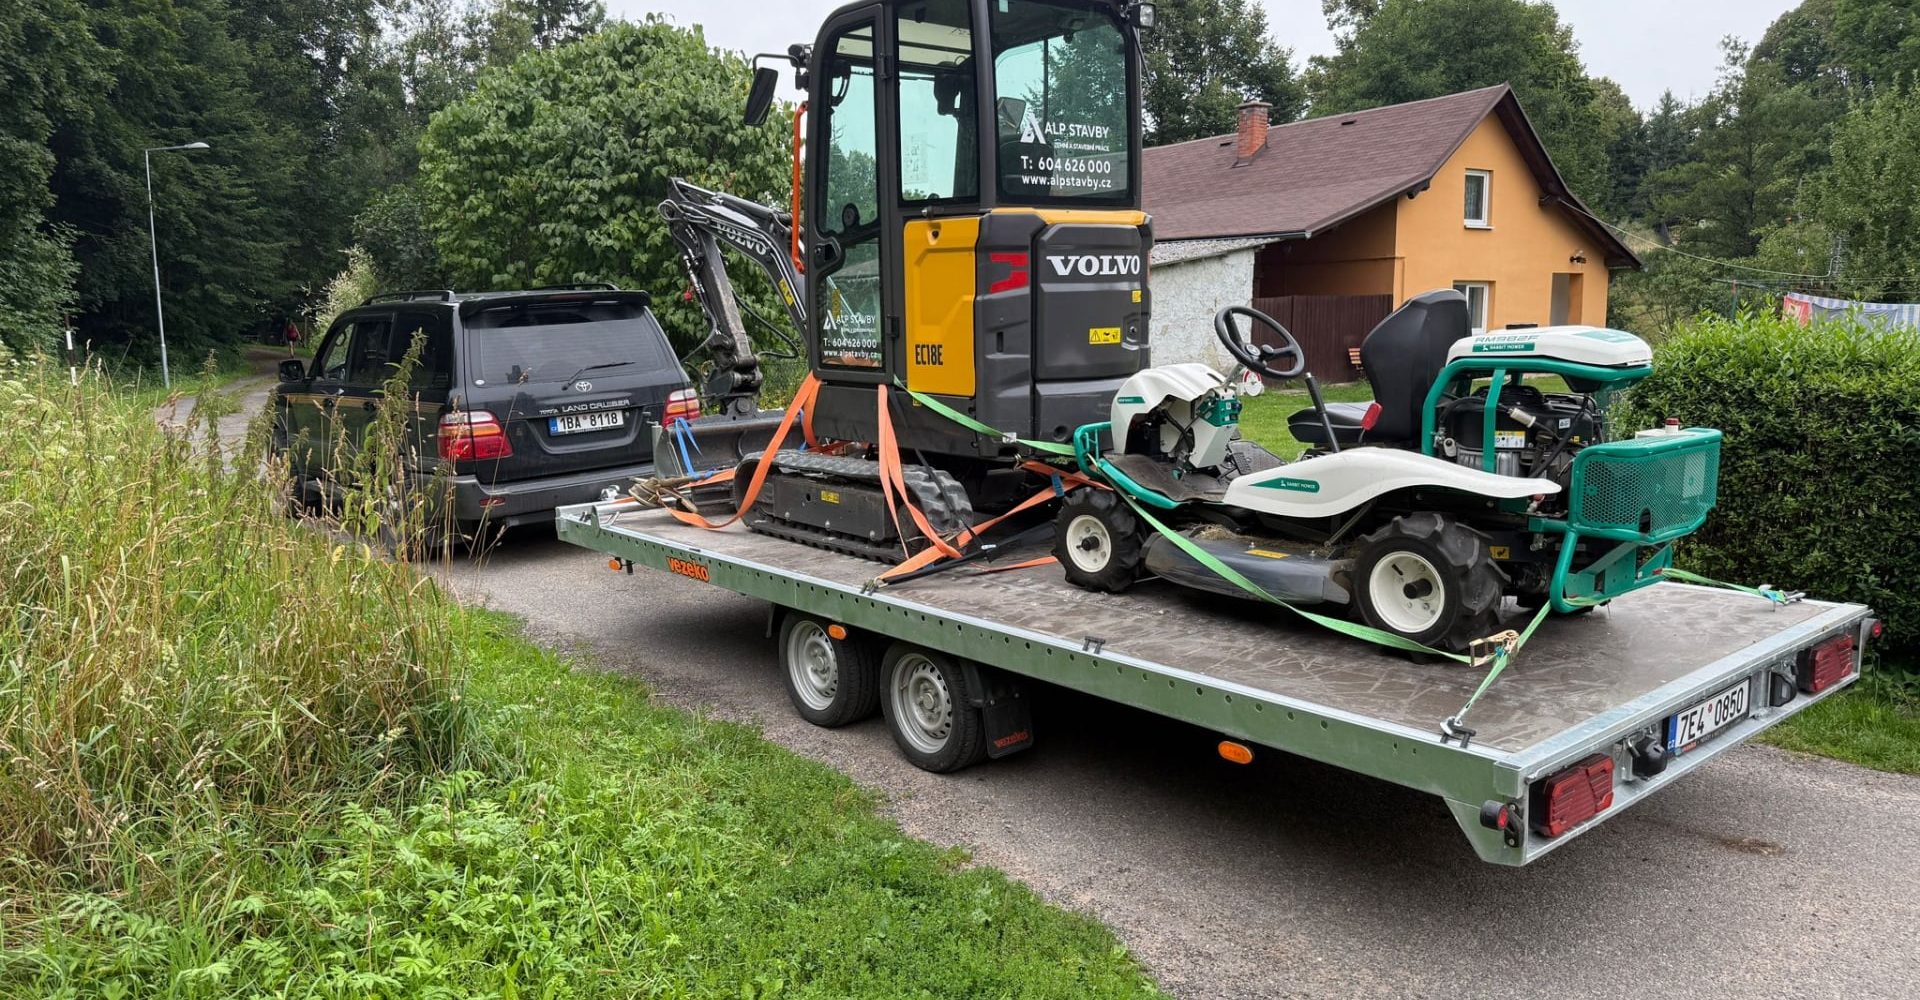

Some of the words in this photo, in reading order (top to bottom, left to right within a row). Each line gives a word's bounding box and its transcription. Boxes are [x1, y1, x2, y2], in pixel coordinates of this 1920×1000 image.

[1044, 121, 1066, 135] ALP
[1069, 124, 1109, 138] STAVBY
[1021, 155, 1033, 170] T:
[1038, 157, 1062, 171] 604
[1064, 158, 1086, 172] 626
[1087, 160, 1111, 174] 000
[1021, 174, 1112, 191] www.alpstavby.cz
[716, 221, 768, 255] VOLVO
[1046, 254, 1140, 276] VOLVO
[823, 337, 831, 347] T:
[861, 339, 878, 348] 000
[823, 349, 878, 360] www.alpstavby.cz
[915, 344, 943, 366] EC18E
[561, 403, 588, 413] LAND
[589, 399, 630, 410] CRUISER
[560, 415, 582, 430] 1BA
[589, 412, 618, 427] 8118
[666, 556, 709, 583] vezeko
[1680, 707, 1705, 744] 7E4
[1714, 687, 1744, 726] 0850
[1667, 739, 1675, 749] CZ
